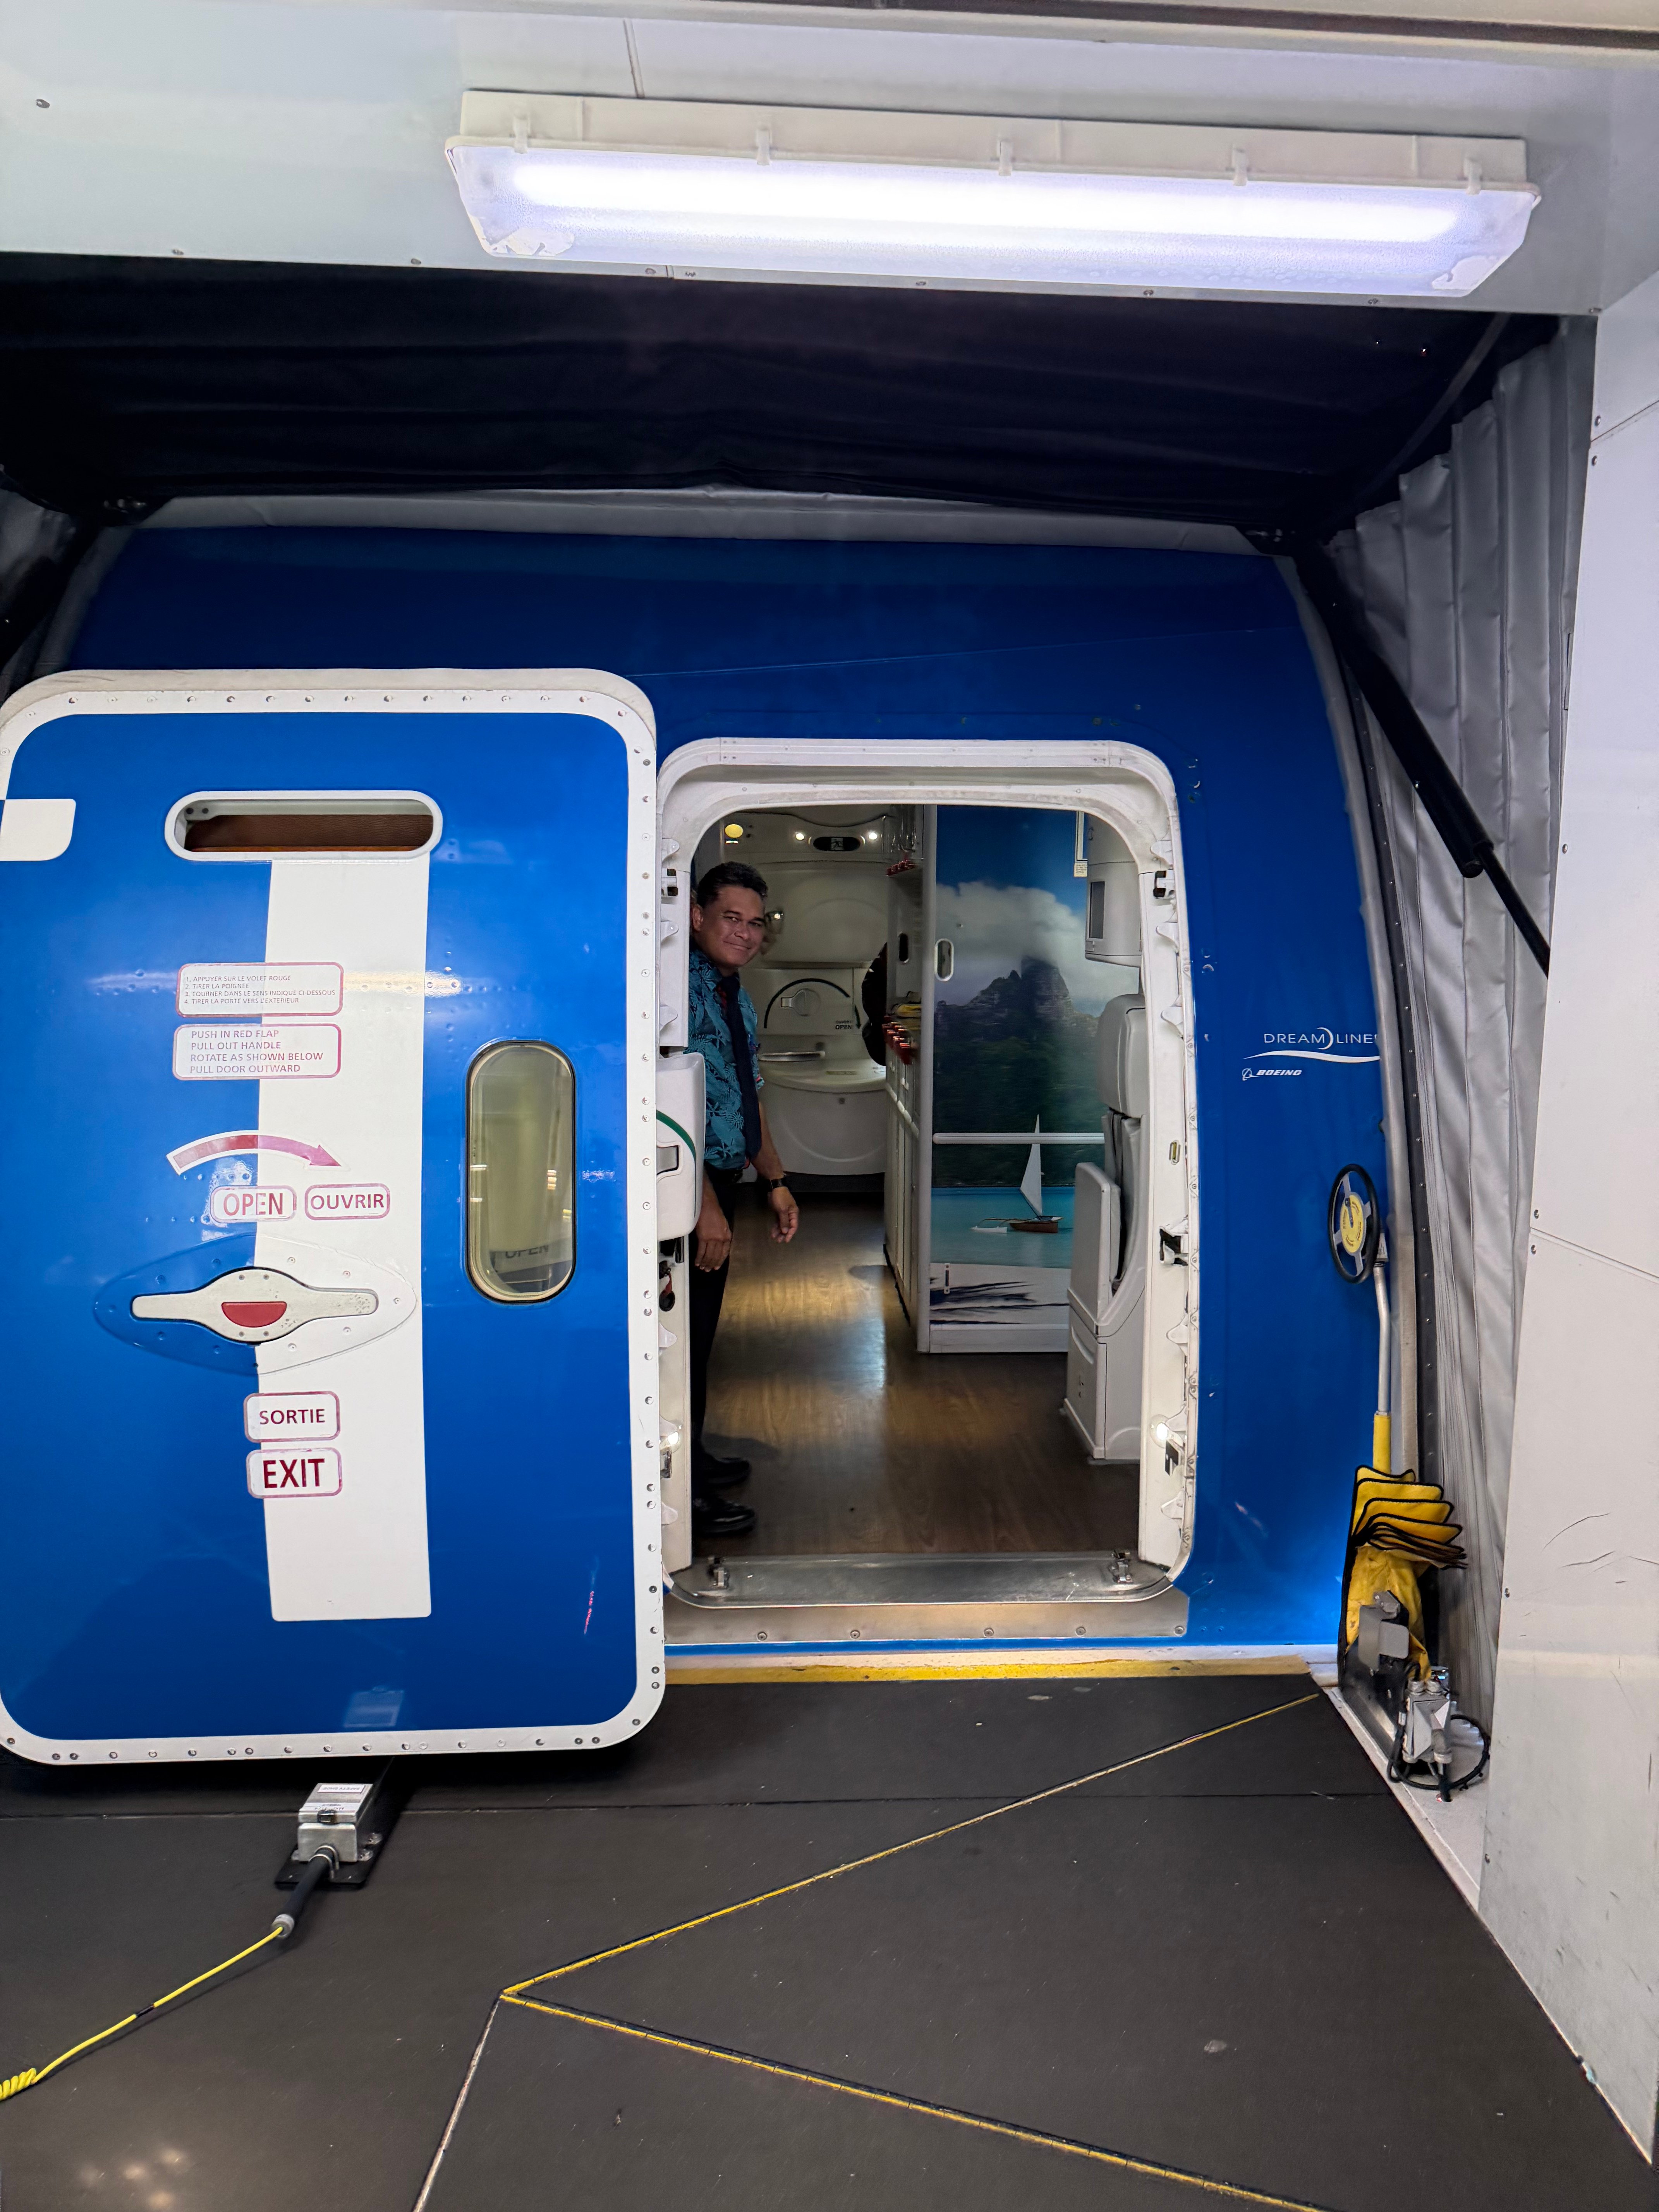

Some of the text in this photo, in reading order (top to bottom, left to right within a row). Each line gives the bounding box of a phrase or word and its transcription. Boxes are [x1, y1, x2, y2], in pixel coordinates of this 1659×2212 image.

[241, 1041, 281, 1049] HANDLE
[223, 1193, 283, 1216] OPEN
[310, 1194, 385, 1210] OUVRIR
[259, 1408, 325, 1425] SORTIE
[263, 1458, 325, 1489] EXIT
